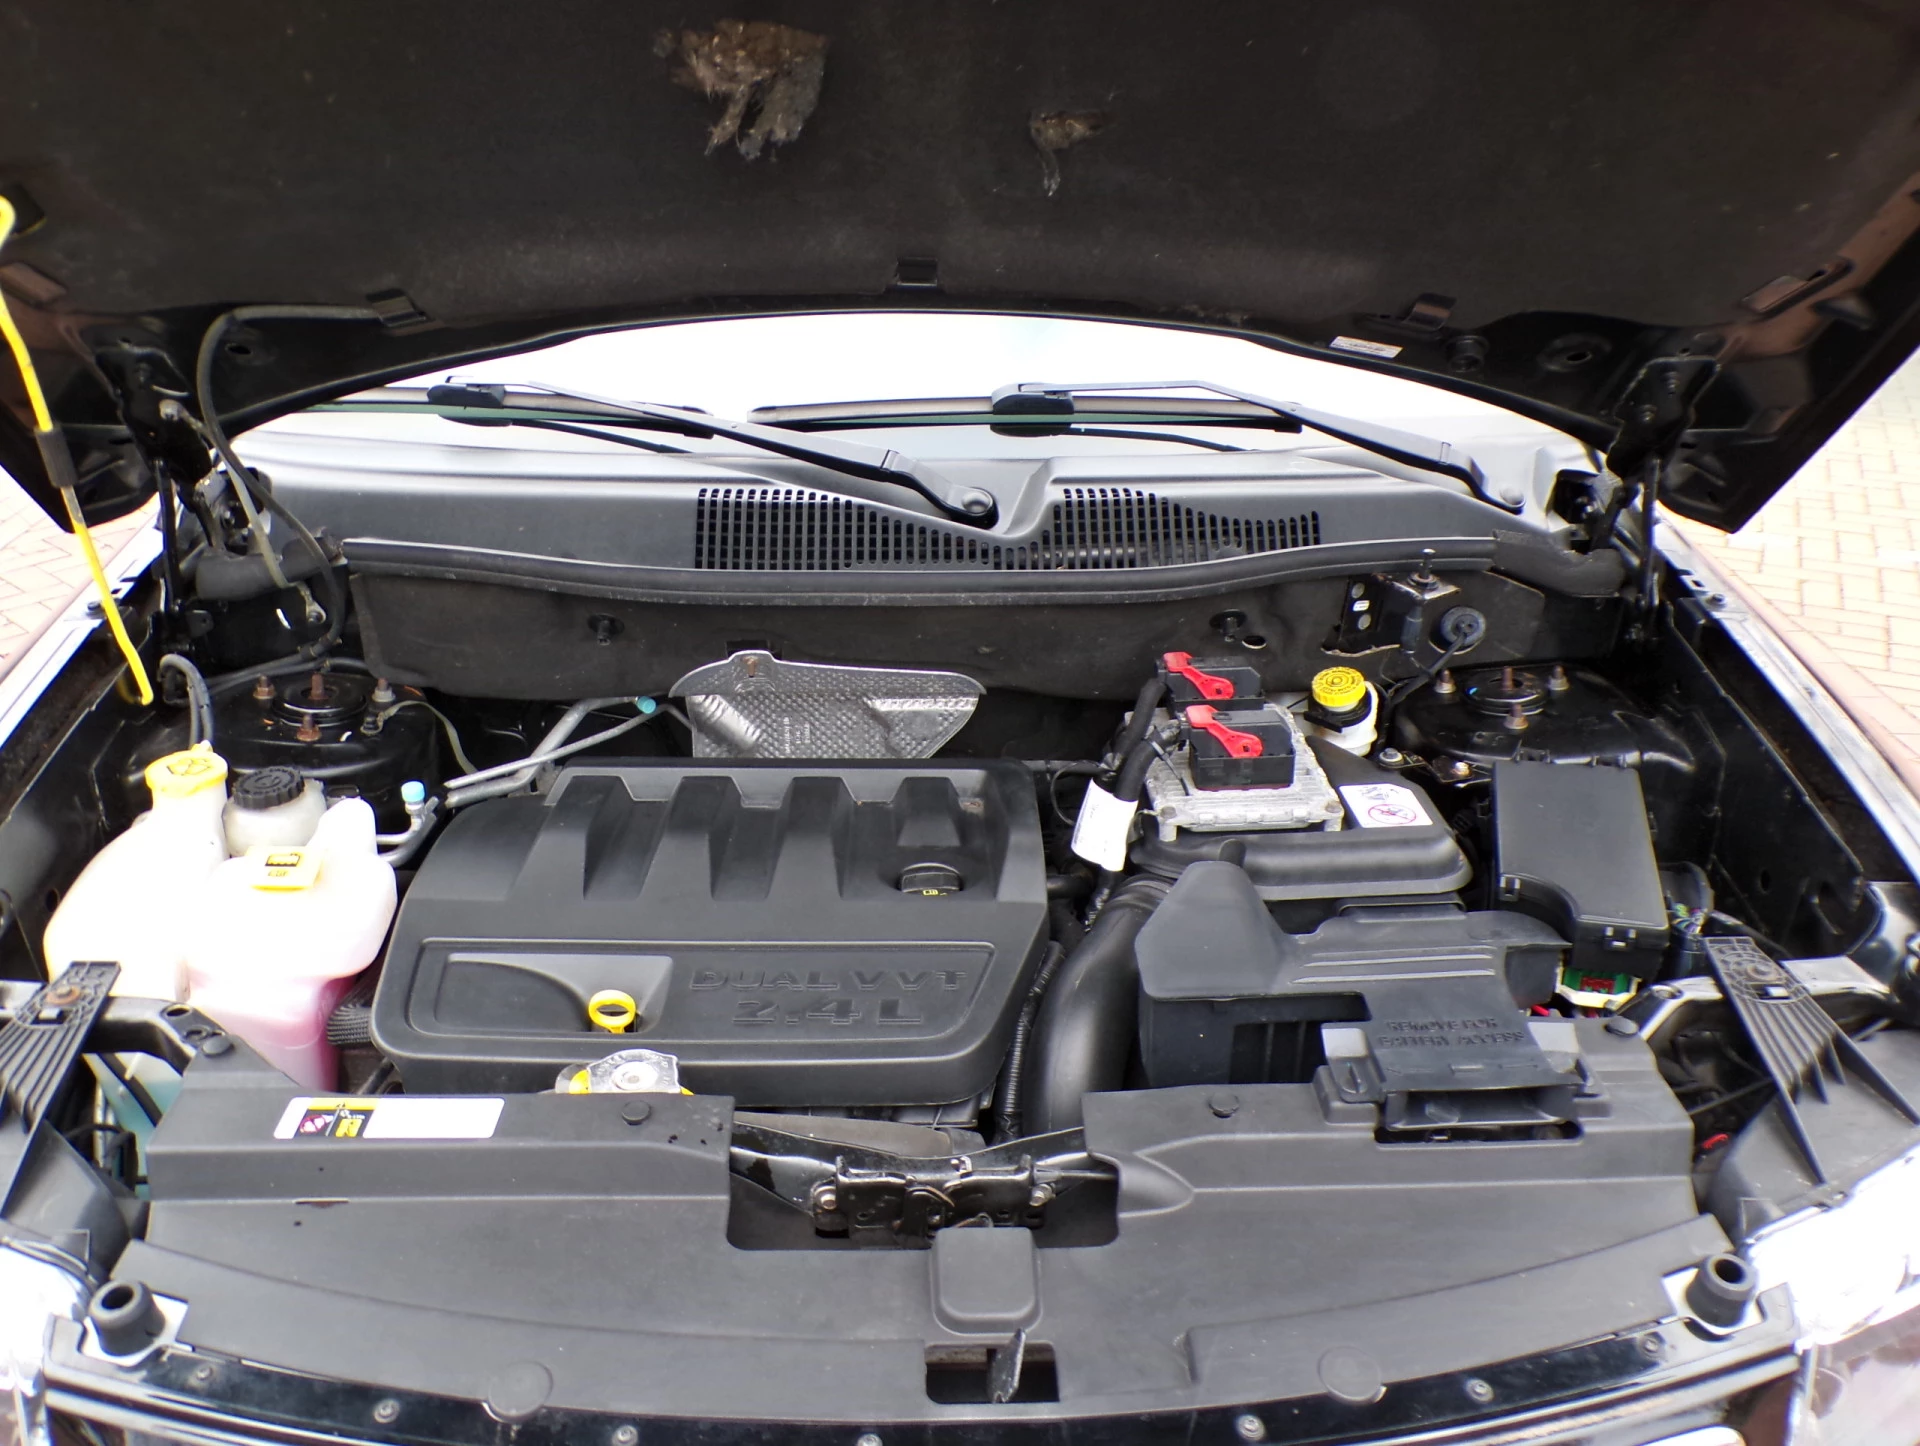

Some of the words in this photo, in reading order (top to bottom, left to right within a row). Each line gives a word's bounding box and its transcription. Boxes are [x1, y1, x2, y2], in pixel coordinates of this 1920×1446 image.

[690, 970, 840, 991] DUAL
[851, 969, 968, 991] VVT
[731, 1000, 923, 1026] 2.4L
[1387, 1021, 1459, 1032] REMOVE
[1464, 1018, 1499, 1031] FOR
[1378, 1036, 1451, 1048] BATTERY
[1458, 1031, 1525, 1046] ACCESS
